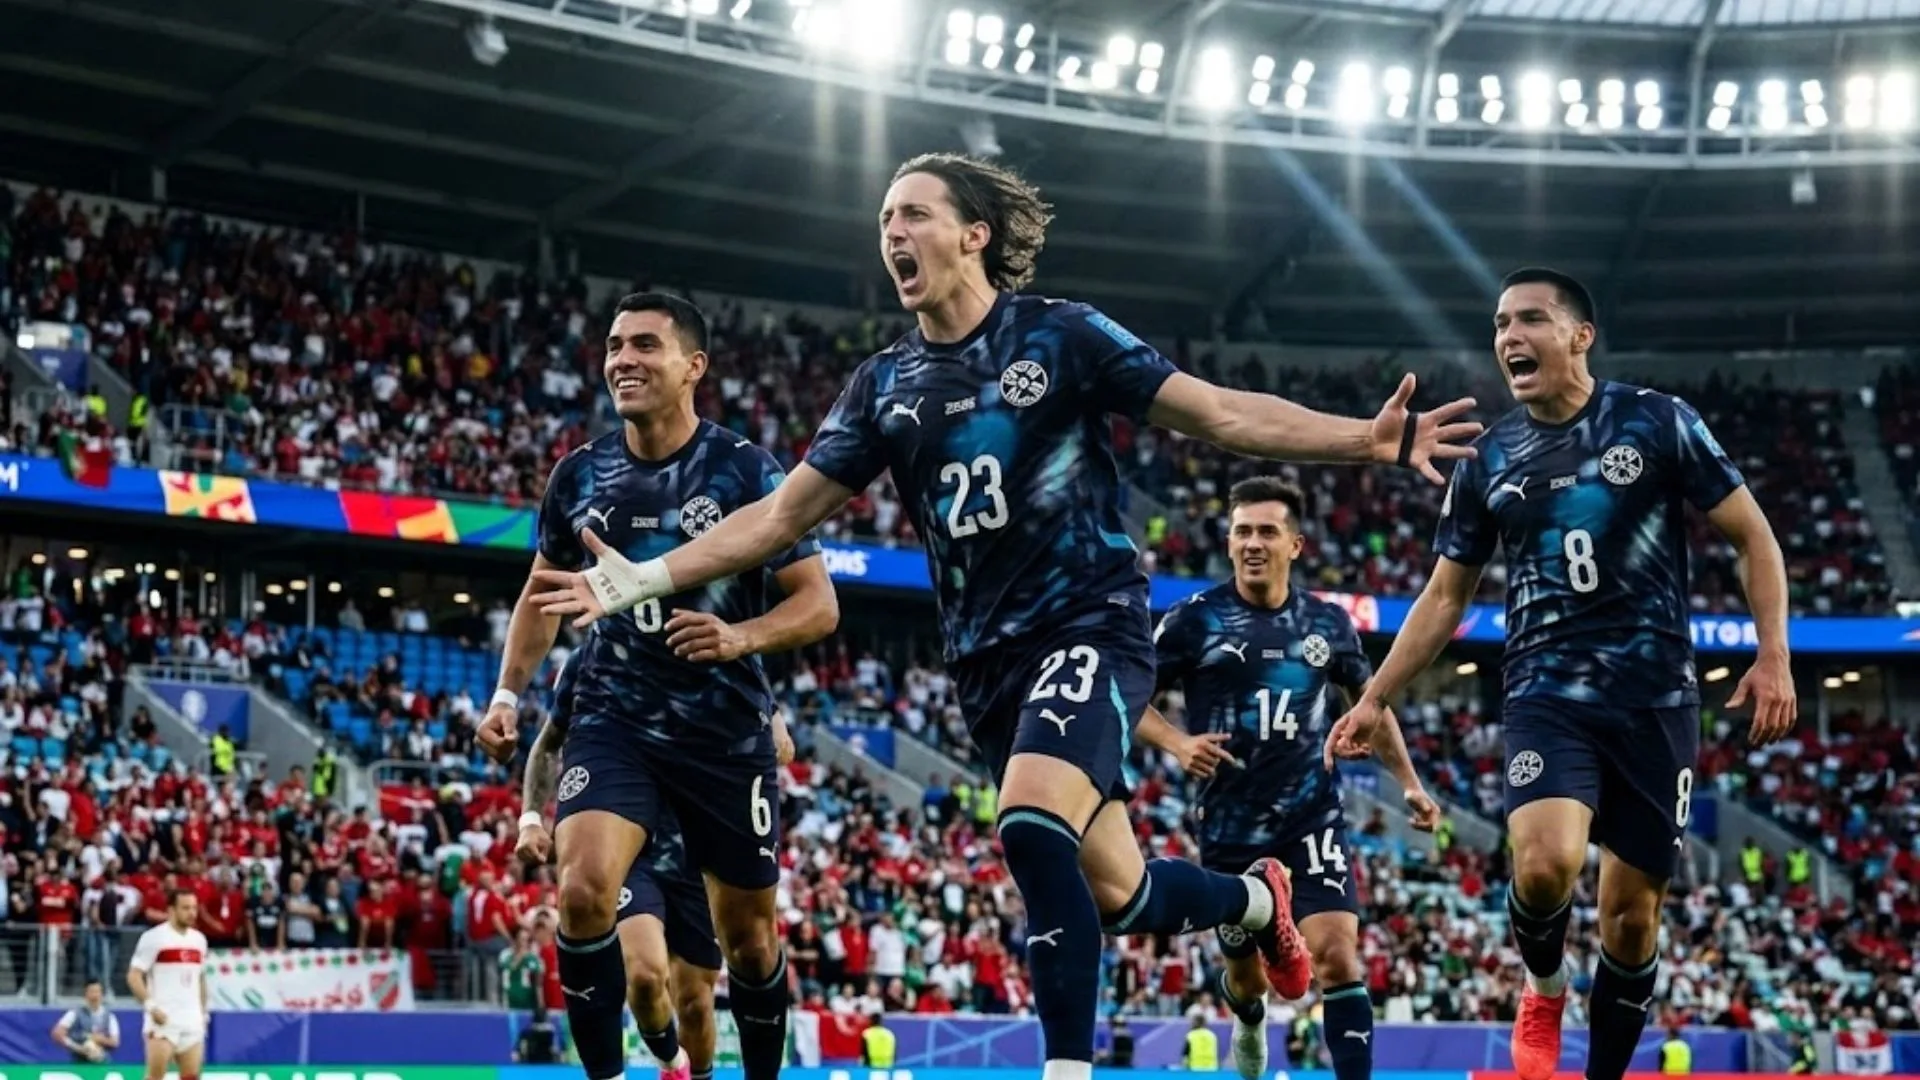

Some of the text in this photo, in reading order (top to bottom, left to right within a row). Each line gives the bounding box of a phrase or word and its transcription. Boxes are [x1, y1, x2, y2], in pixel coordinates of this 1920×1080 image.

[940, 454, 1009, 539] 23
[1564, 529, 1598, 593] 8
[1028, 645, 1100, 703] 23
[1255, 688, 1299, 741] 14
[751, 774, 772, 836] 6
[1675, 767, 1693, 828] 8
[1302, 827, 1348, 875] 14
